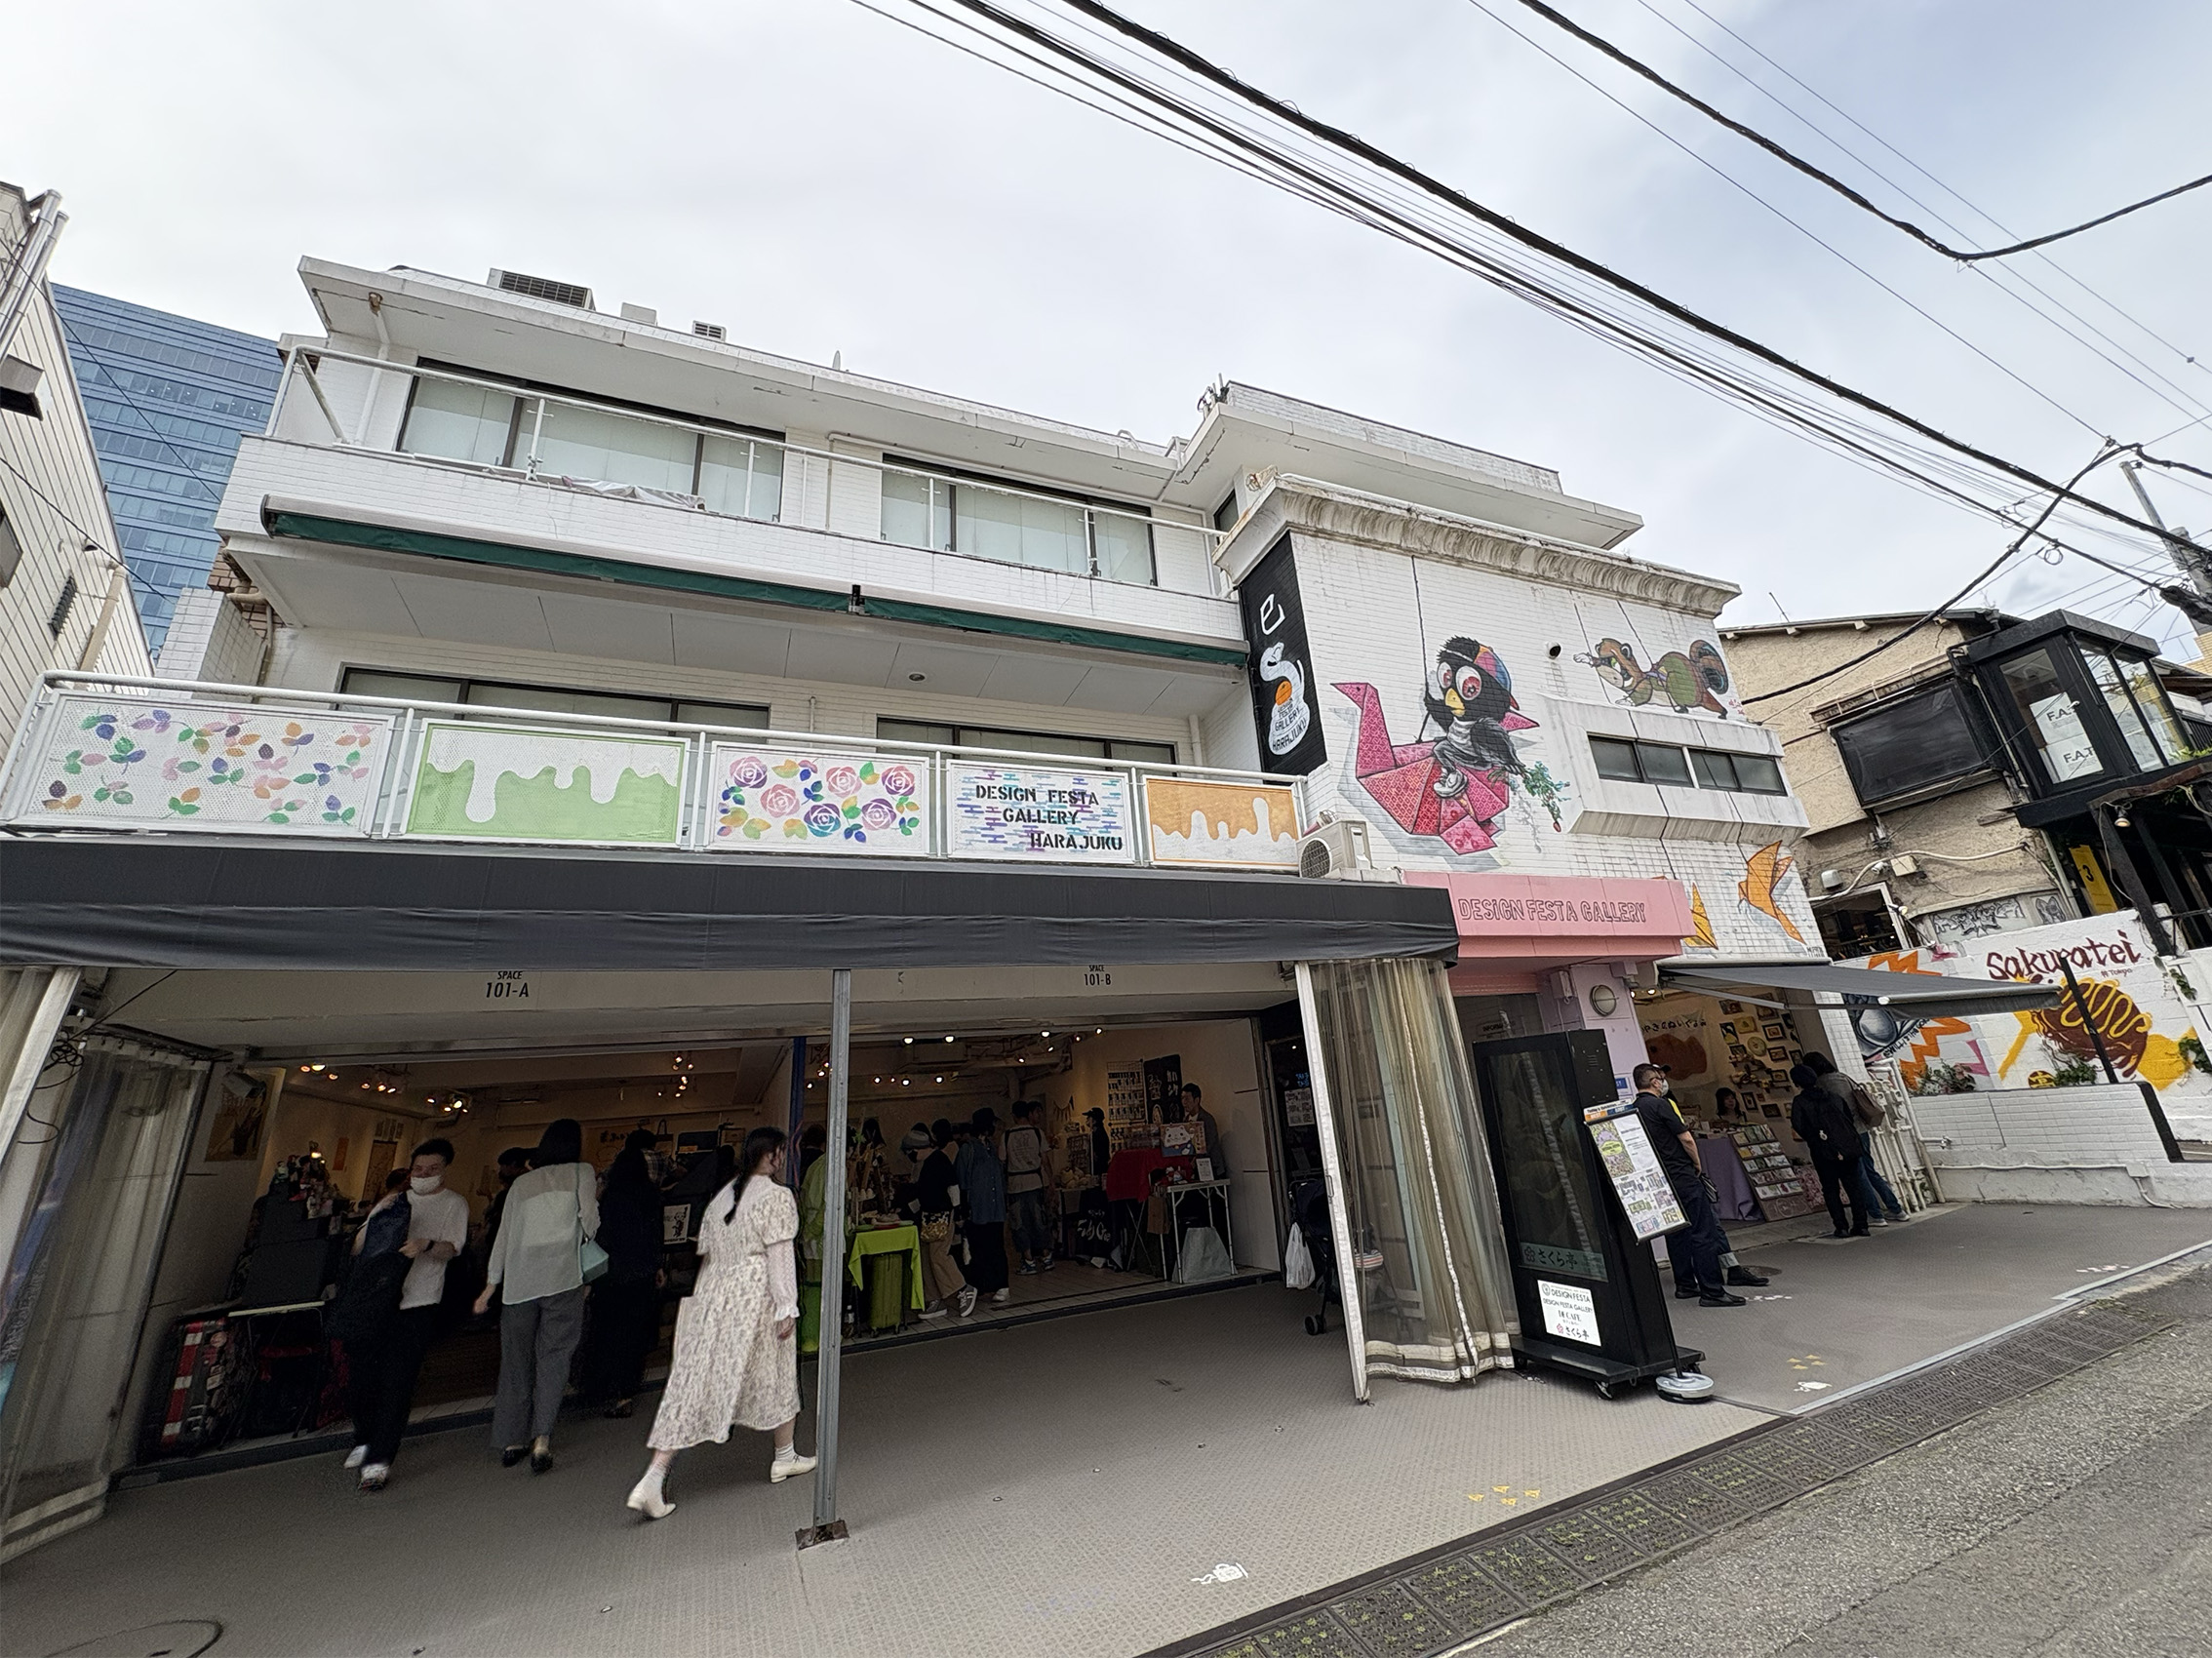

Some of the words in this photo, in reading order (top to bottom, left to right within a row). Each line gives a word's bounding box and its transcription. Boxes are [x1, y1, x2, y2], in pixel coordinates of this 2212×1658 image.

[1275, 707, 1301, 731] GALLERY
[2046, 704, 2076, 722] F.A.
[1272, 717, 1307, 751] HARAJUKU
[976, 785, 1037, 802] DESIGN
[1047, 790, 1099, 806] FESTA
[1003, 809, 1080, 825] GALLERY
[1031, 834, 1123, 850] HARAJUKU
[1526, 900, 1578, 922] FESTA
[1580, 901, 1646, 923] GALLERY
[497, 970, 523, 979] SPACE
[1088, 964, 1105, 972] SPACE
[1084, 973, 1111, 986] 101-B
[487, 982, 529, 998] 101-A
[1538, 1248, 1577, 1270] さくら亭
[1551, 1288, 1572, 1299] DESIGN
[1572, 1292, 1591, 1303] FESTA
